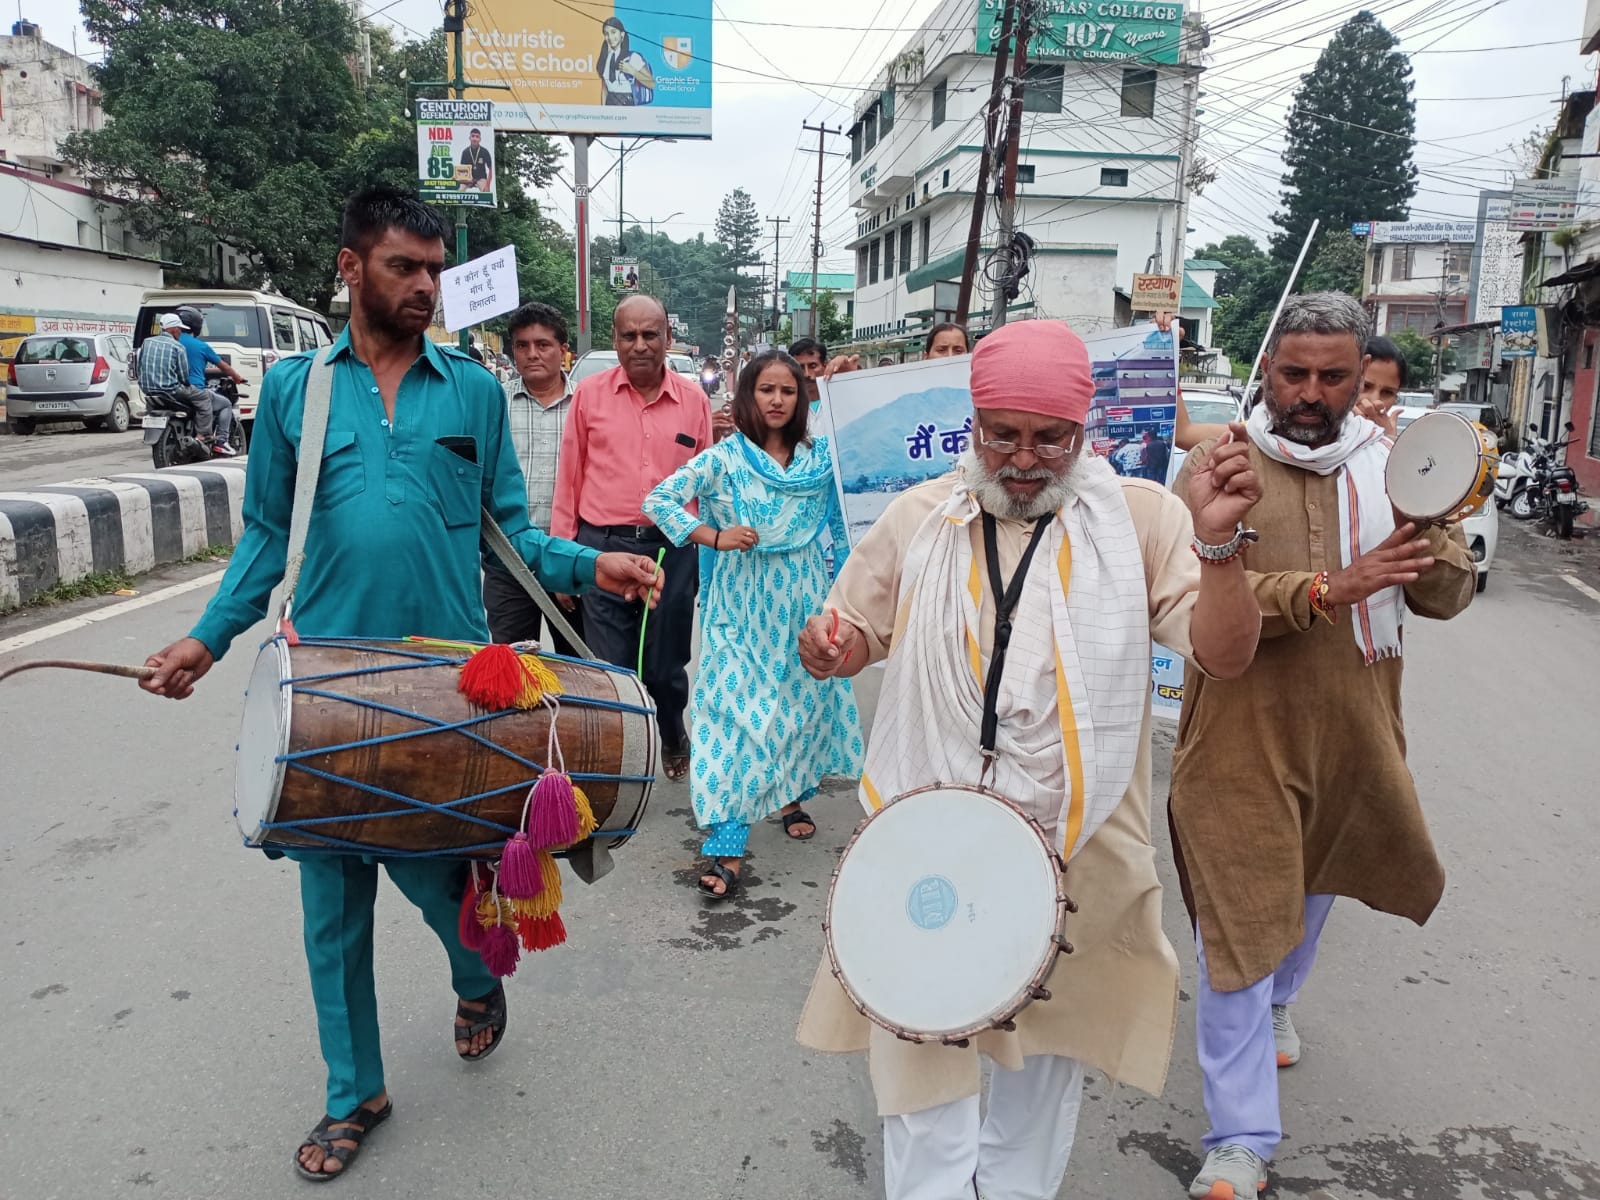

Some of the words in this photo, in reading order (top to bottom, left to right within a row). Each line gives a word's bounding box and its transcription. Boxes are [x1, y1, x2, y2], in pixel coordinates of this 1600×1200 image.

[1097, 3, 1177, 20] COLLEGE
[465, 28, 565, 49] Futuristic
[1063, 22, 1116, 48] 107
[1123, 30, 1166, 47] Years
[465, 53, 516, 70] ICSE
[521, 54, 593, 73] School
[656, 76, 687, 86] Graphic
[420, 102, 488, 112] CENTURION
[421, 111, 453, 120] DEFENCE
[454, 112, 488, 120] ACADEMY
[428, 127, 453, 140] NDA
[431, 145, 450, 156] AIR
[427, 157, 454, 178] 85
[469, 294, 497, 312] हिमालय
[42, 321, 58, 332] अब
[906, 424, 935, 459] मैं
